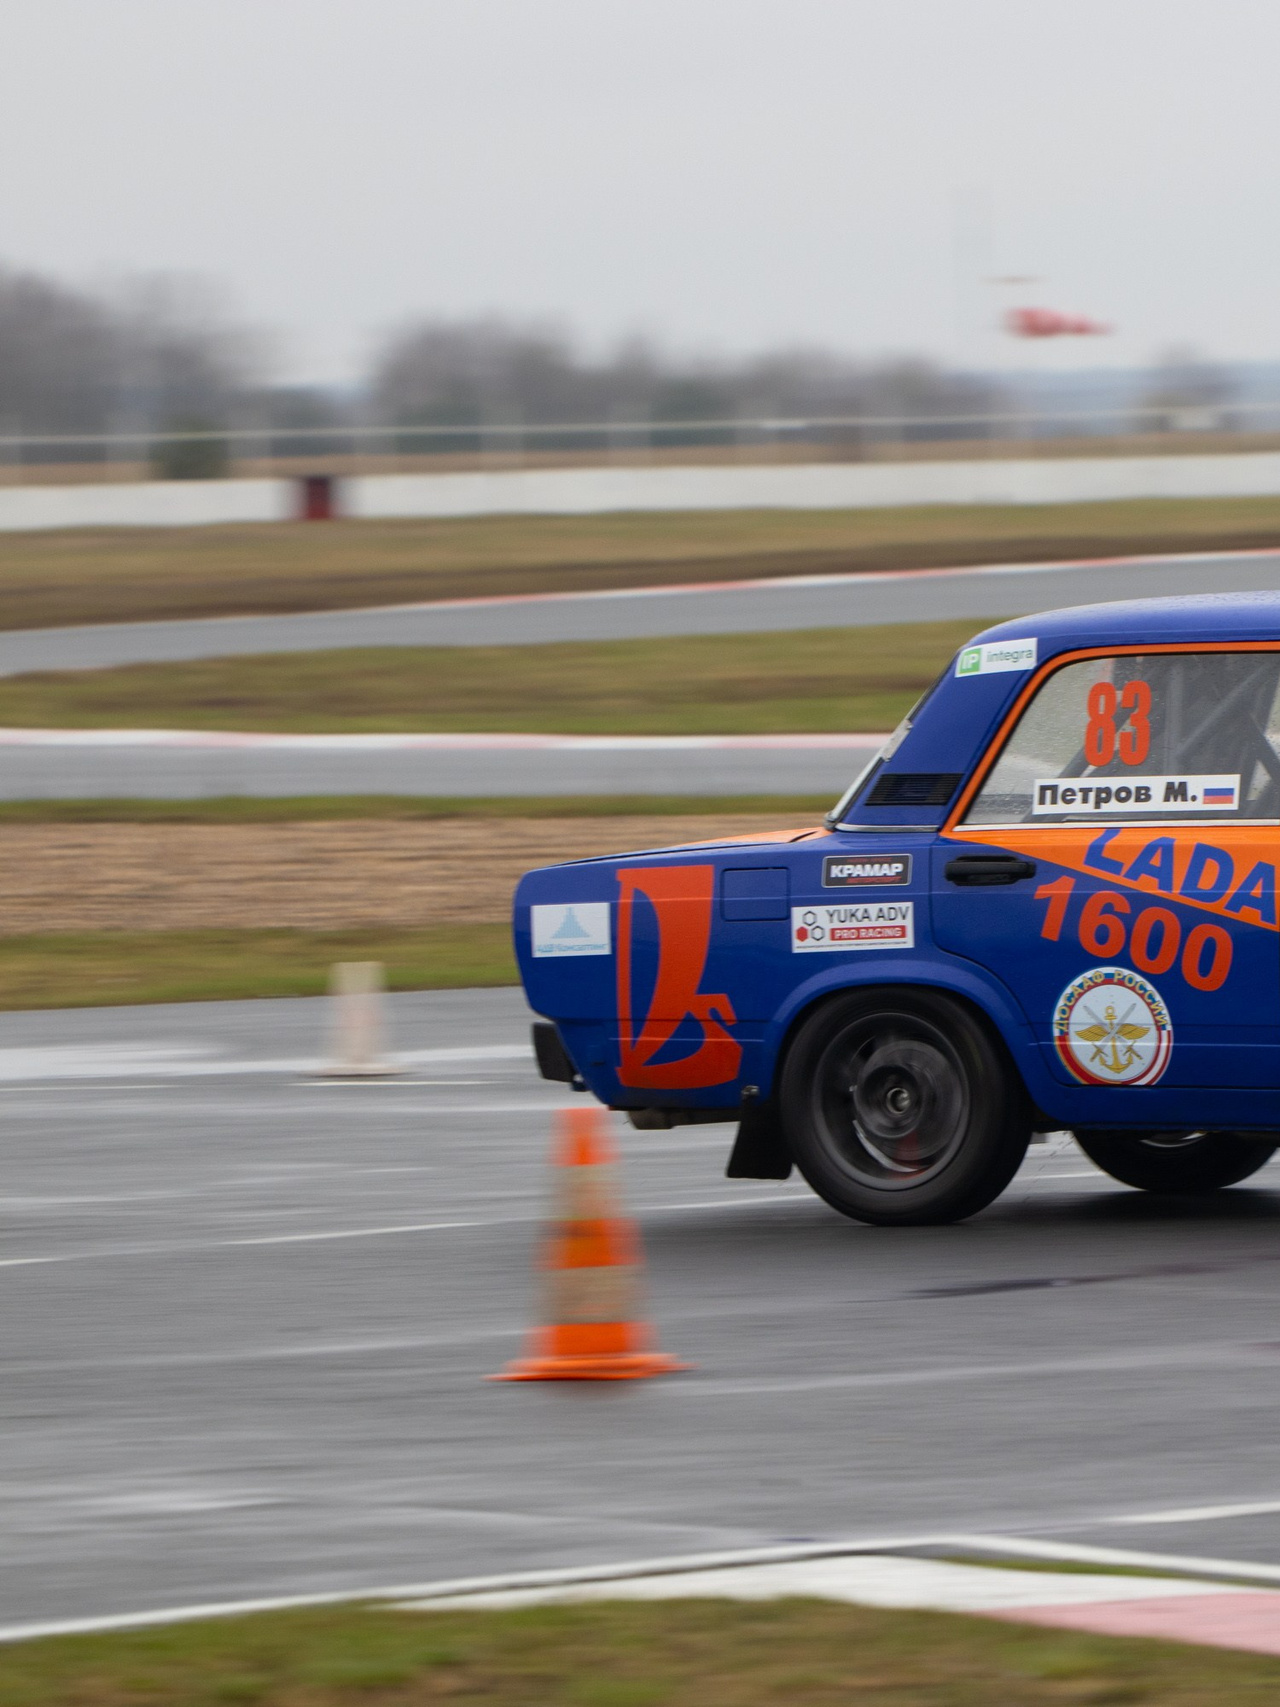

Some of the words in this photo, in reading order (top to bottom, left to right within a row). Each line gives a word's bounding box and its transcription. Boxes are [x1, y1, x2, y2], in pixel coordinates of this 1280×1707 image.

[985, 649, 1034, 663] integra
[1084, 680, 1152, 767] 83
[1038, 784, 1152, 809] Петров
[1163, 781, 1197, 803] М.
[830, 863, 904, 878] КРАМАР
[1083, 829, 1277, 926] LADA
[826, 908, 871, 923] YUKA
[875, 906, 910, 921] ADV
[834, 929, 858, 939] PRO
[859, 927, 903, 938] RACING
[1034, 875, 1233, 992] 1600
[1055, 970, 1105, 1032] ДОСААФ
[1113, 970, 1168, 1027] РОССИИ
